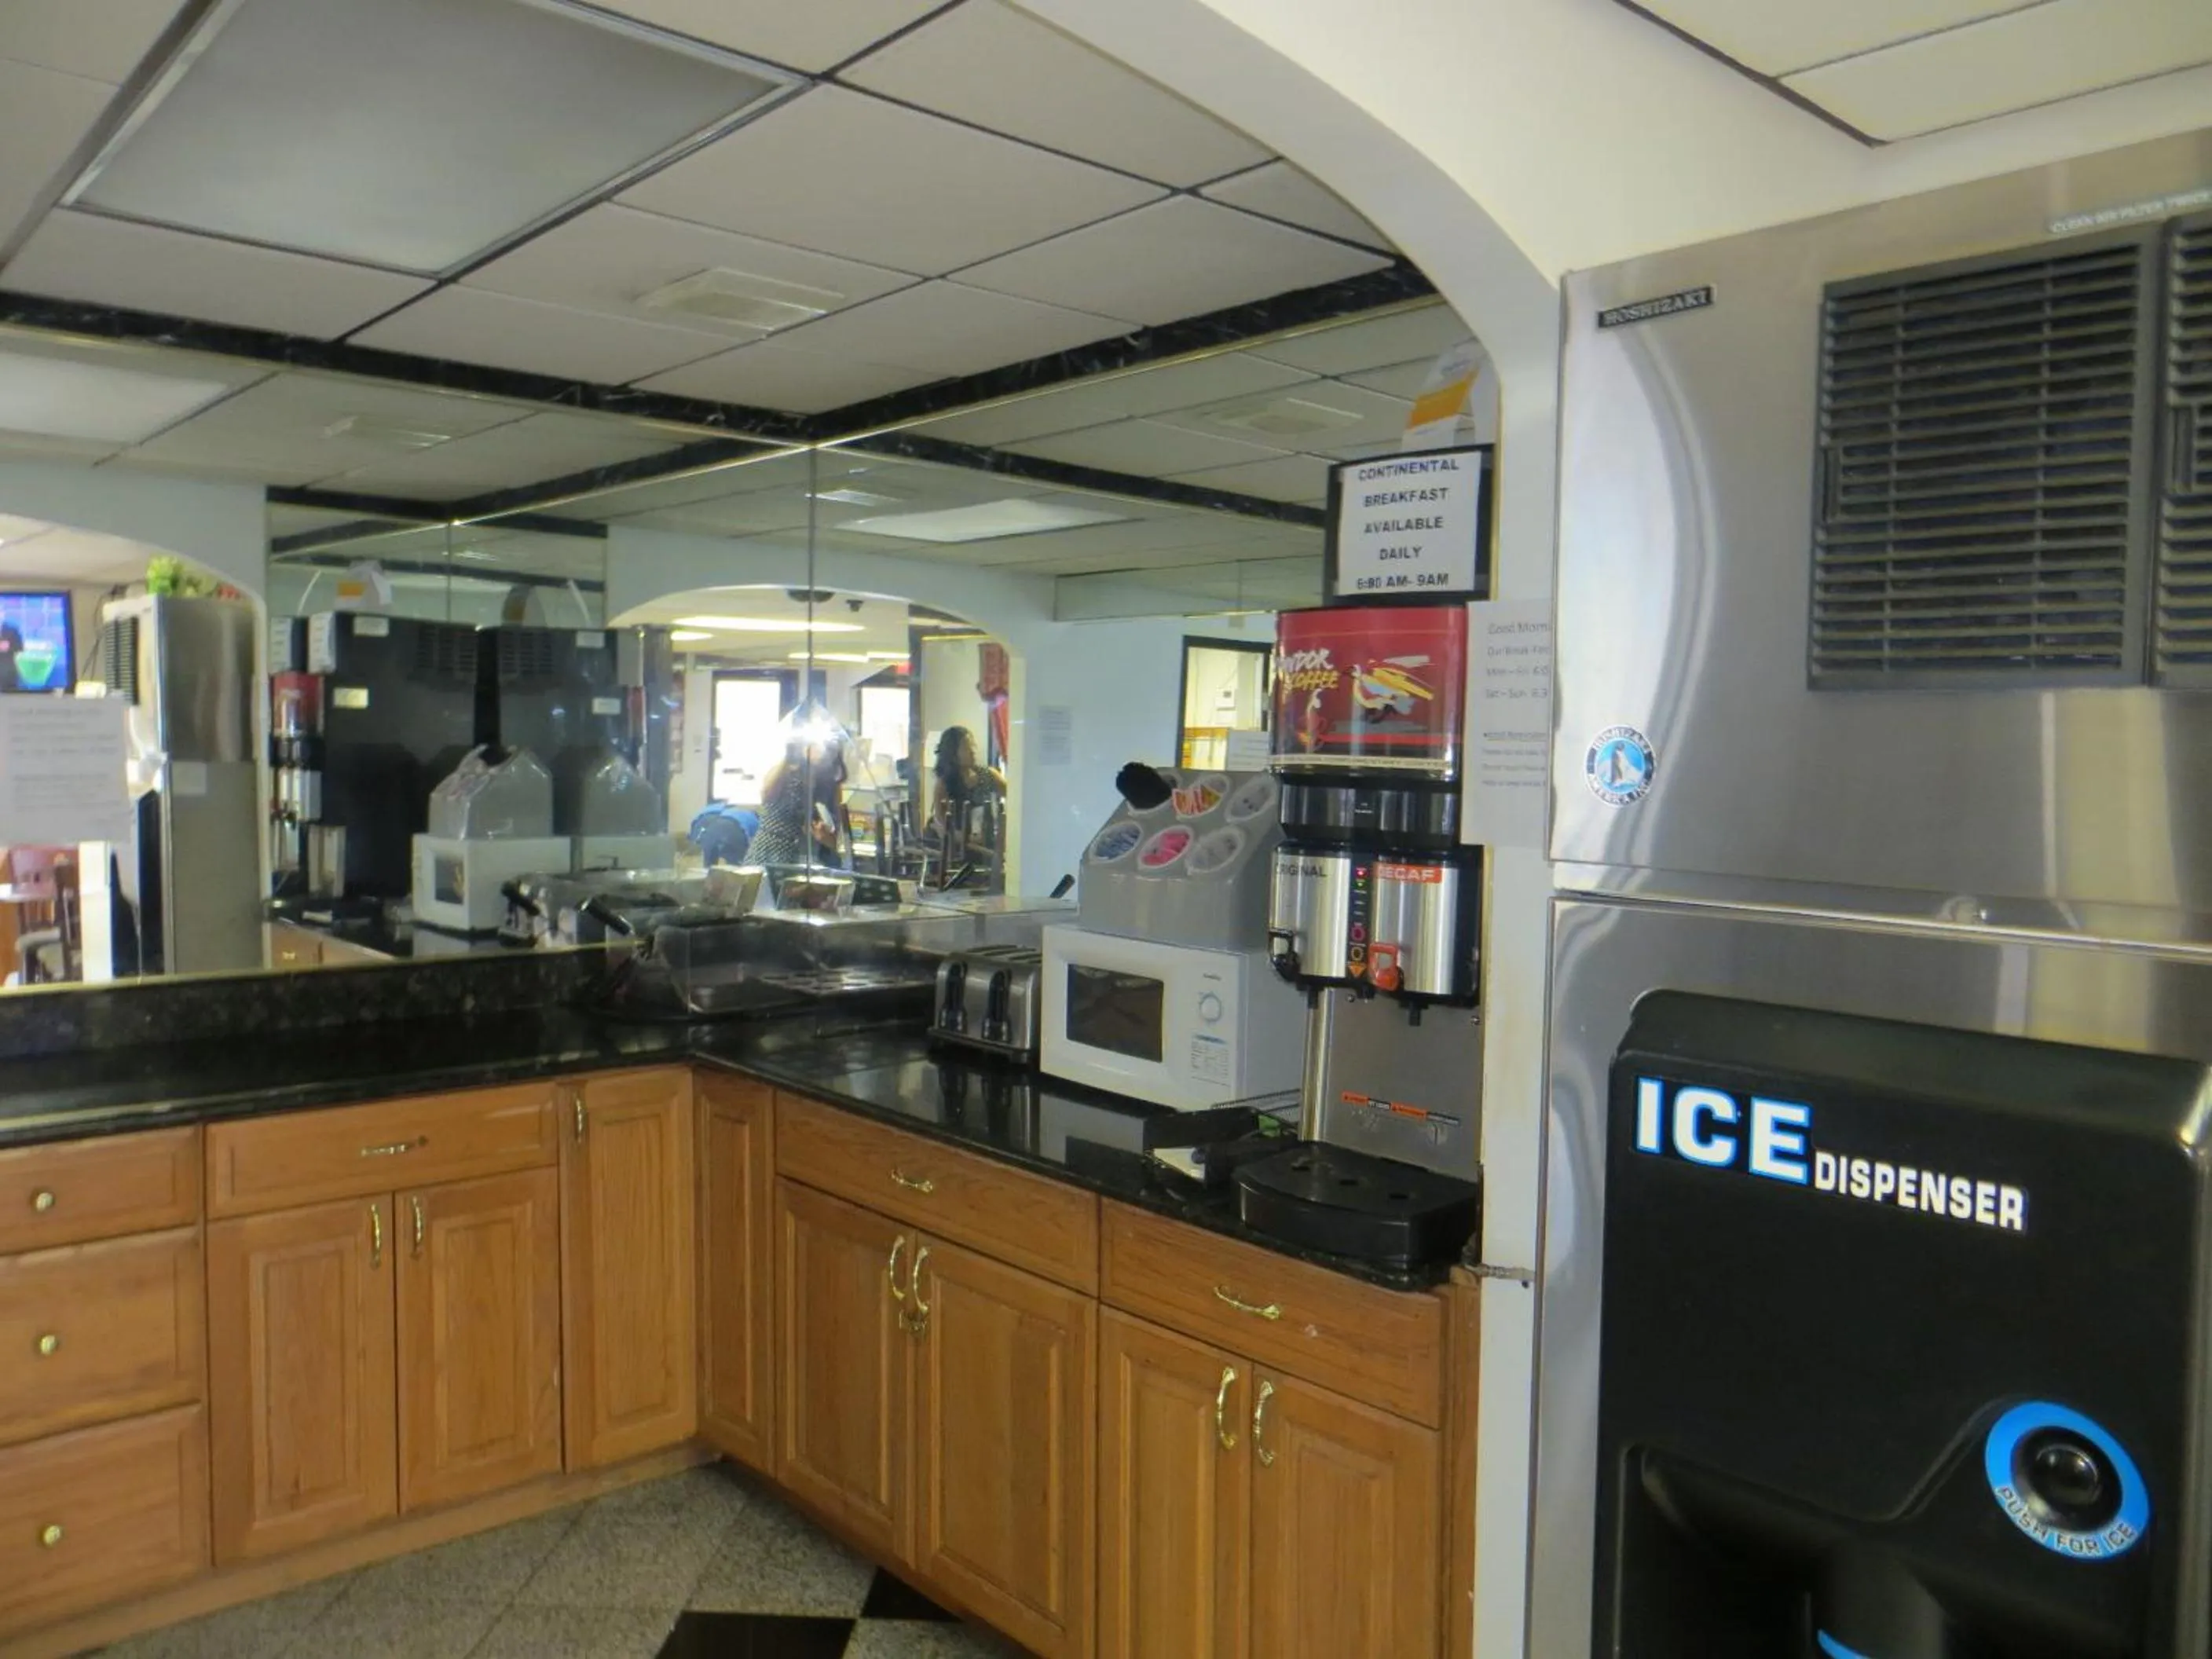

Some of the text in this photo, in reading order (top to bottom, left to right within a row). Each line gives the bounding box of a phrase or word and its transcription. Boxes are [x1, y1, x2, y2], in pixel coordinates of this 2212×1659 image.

[1603, 289, 1708, 324] HOSHIZAKI
[1358, 458, 1459, 481] CONTINENTAL
[1364, 487, 1449, 507] BREAKFAST
[1364, 515, 1444, 534] AVAILABLE
[1379, 546, 1423, 561] DAILY
[1379, 865, 1435, 881] DECAF
[1636, 1076, 2025, 1232] ICE DISPENSER
[1995, 1485, 2138, 1558] PUSH FOR ICE
